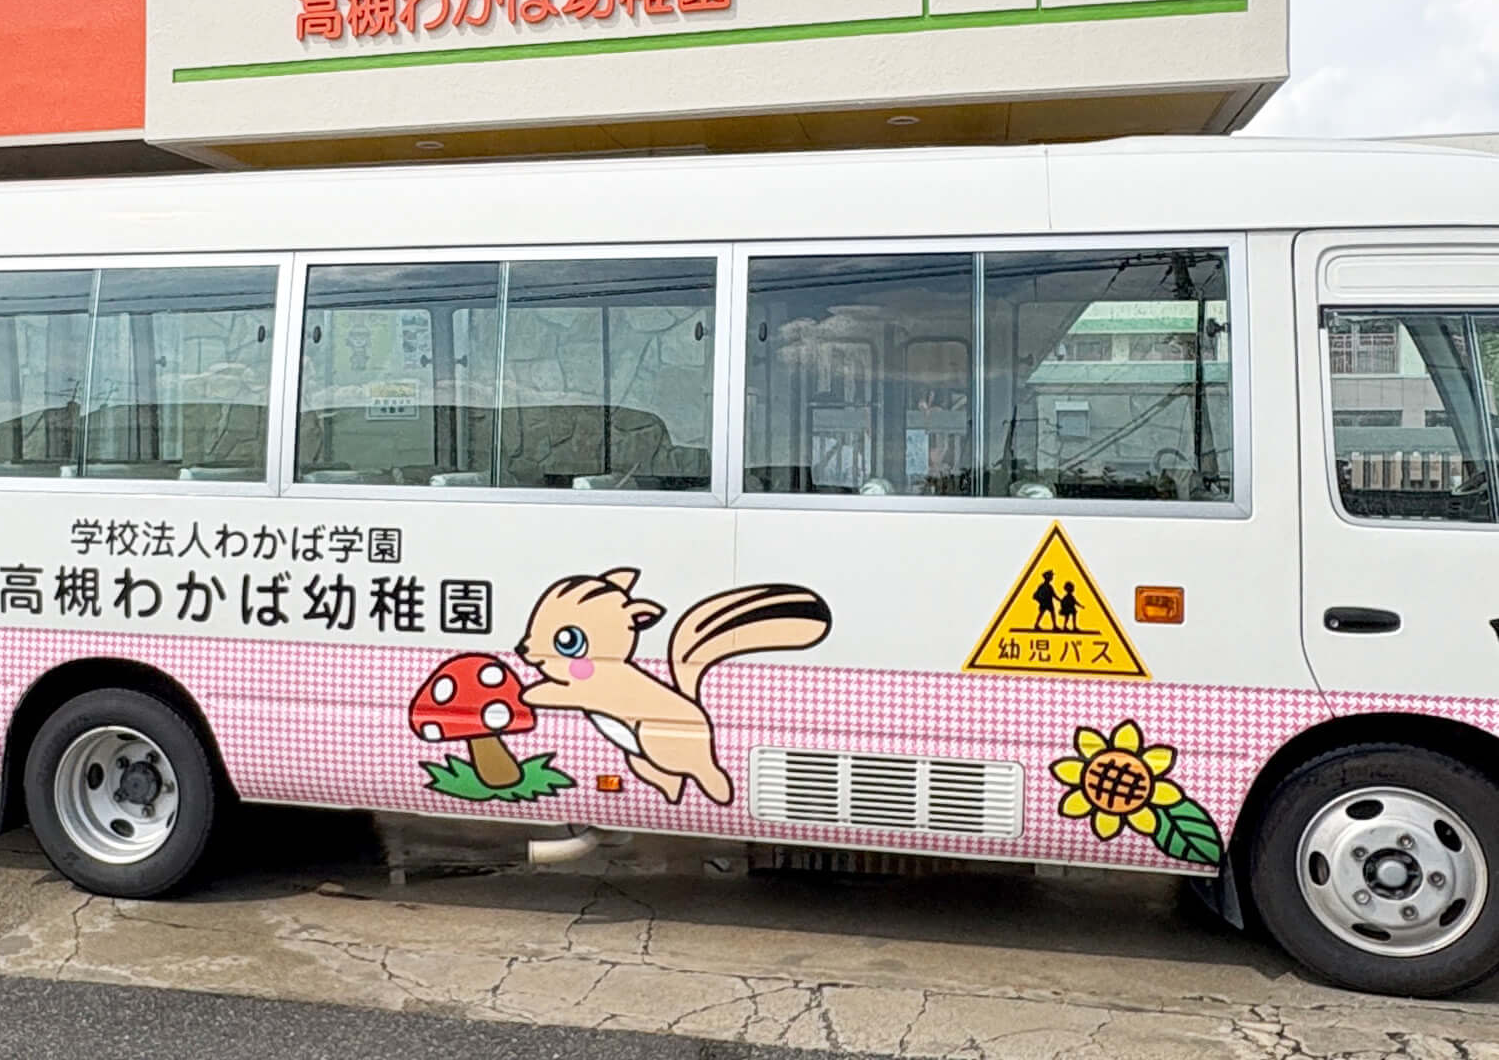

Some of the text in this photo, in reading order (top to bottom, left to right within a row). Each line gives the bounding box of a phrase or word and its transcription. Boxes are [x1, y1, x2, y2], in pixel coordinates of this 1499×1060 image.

[70, 519, 402, 564] 学校法人わかば学園
[0, 564, 494, 635] 高槻わかば幼稚園
[997, 637, 1113, 664] 幼児バス
